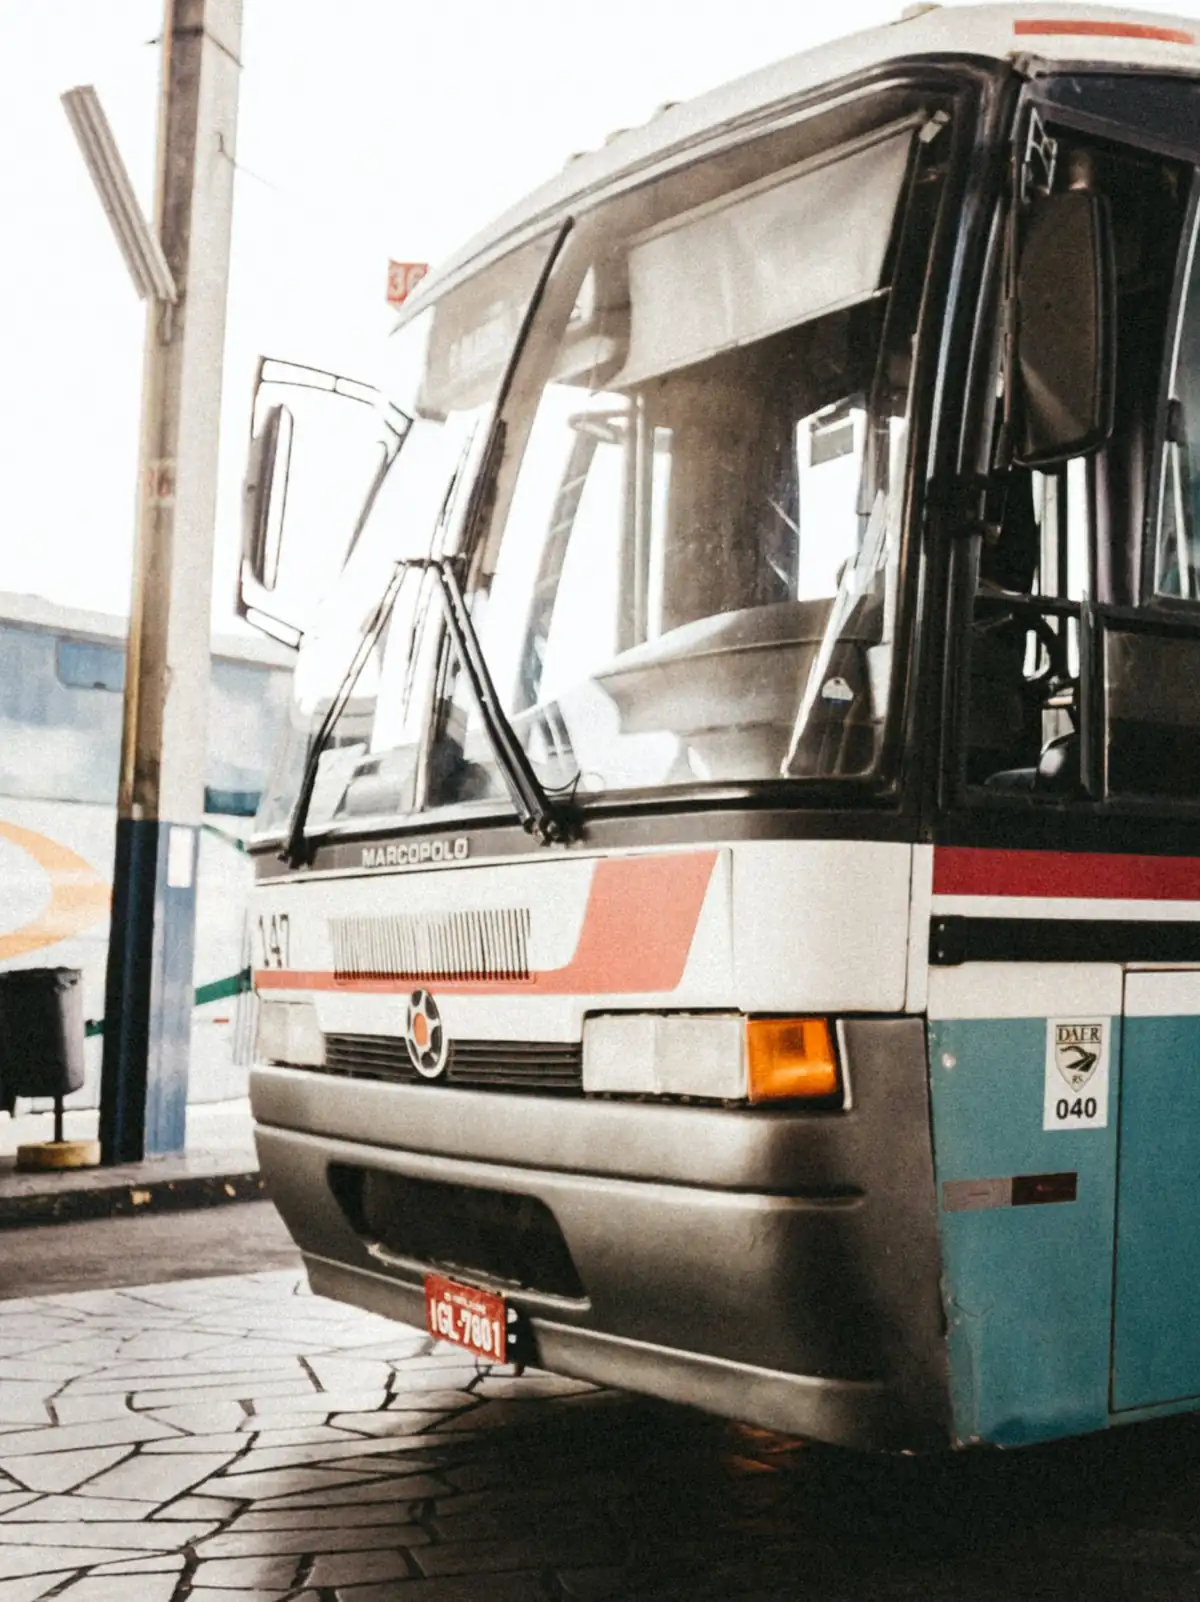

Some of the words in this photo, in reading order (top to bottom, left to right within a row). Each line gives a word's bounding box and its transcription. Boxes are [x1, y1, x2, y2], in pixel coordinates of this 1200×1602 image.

[361, 837, 470, 868] MARCOPOLO
[1058, 1027, 1101, 1041] DAER
[1056, 1097, 1098, 1120] 040
